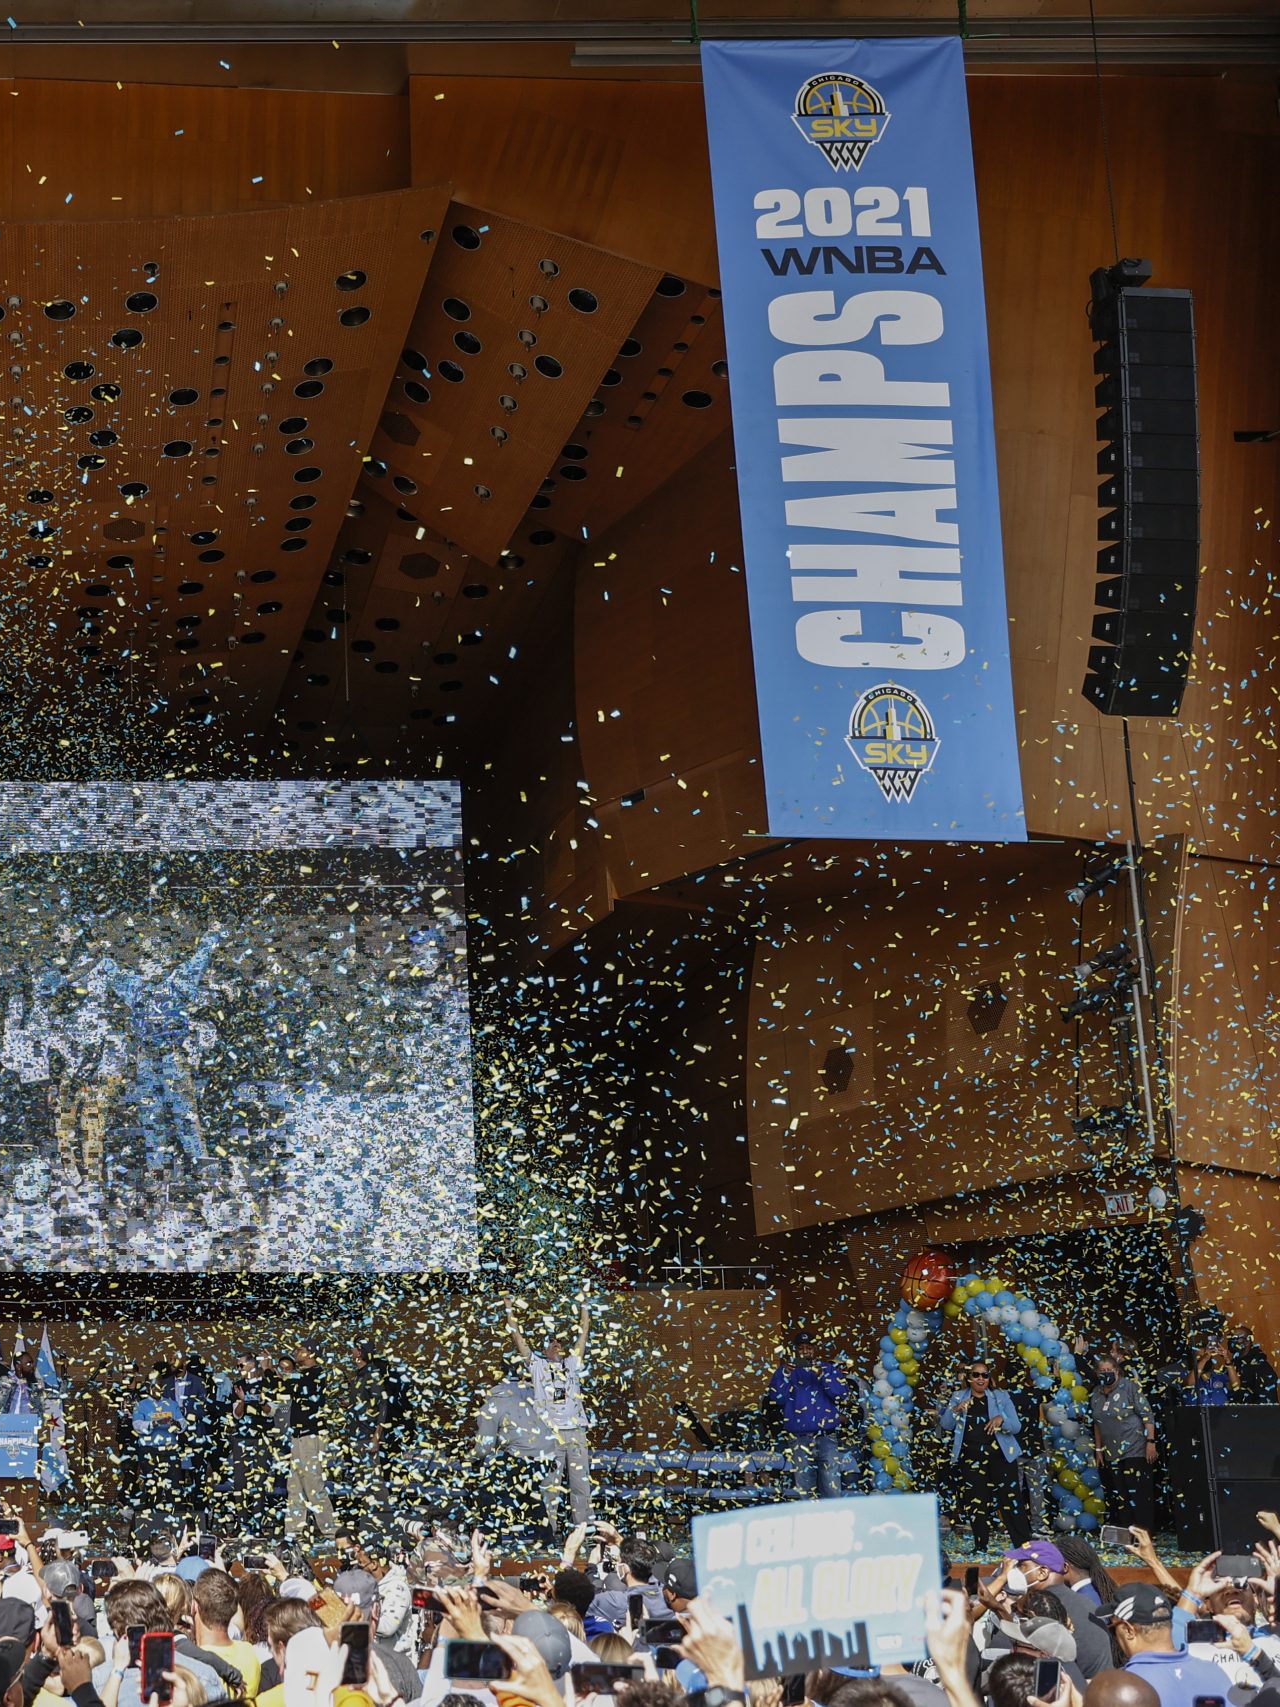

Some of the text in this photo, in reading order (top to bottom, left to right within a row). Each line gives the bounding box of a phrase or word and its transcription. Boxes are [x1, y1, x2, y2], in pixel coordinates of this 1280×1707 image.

[812, 75, 859, 86] CHICAGO
[809, 118, 877, 138] SKY
[753, 186, 932, 239] 2021
[760, 246, 947, 277] WNBA
[767, 290, 966, 670] CHAMPS
[868, 688, 913, 702] CHICAGO
[863, 742, 928, 765] SKY
[752, 1565, 808, 1628] ALL
